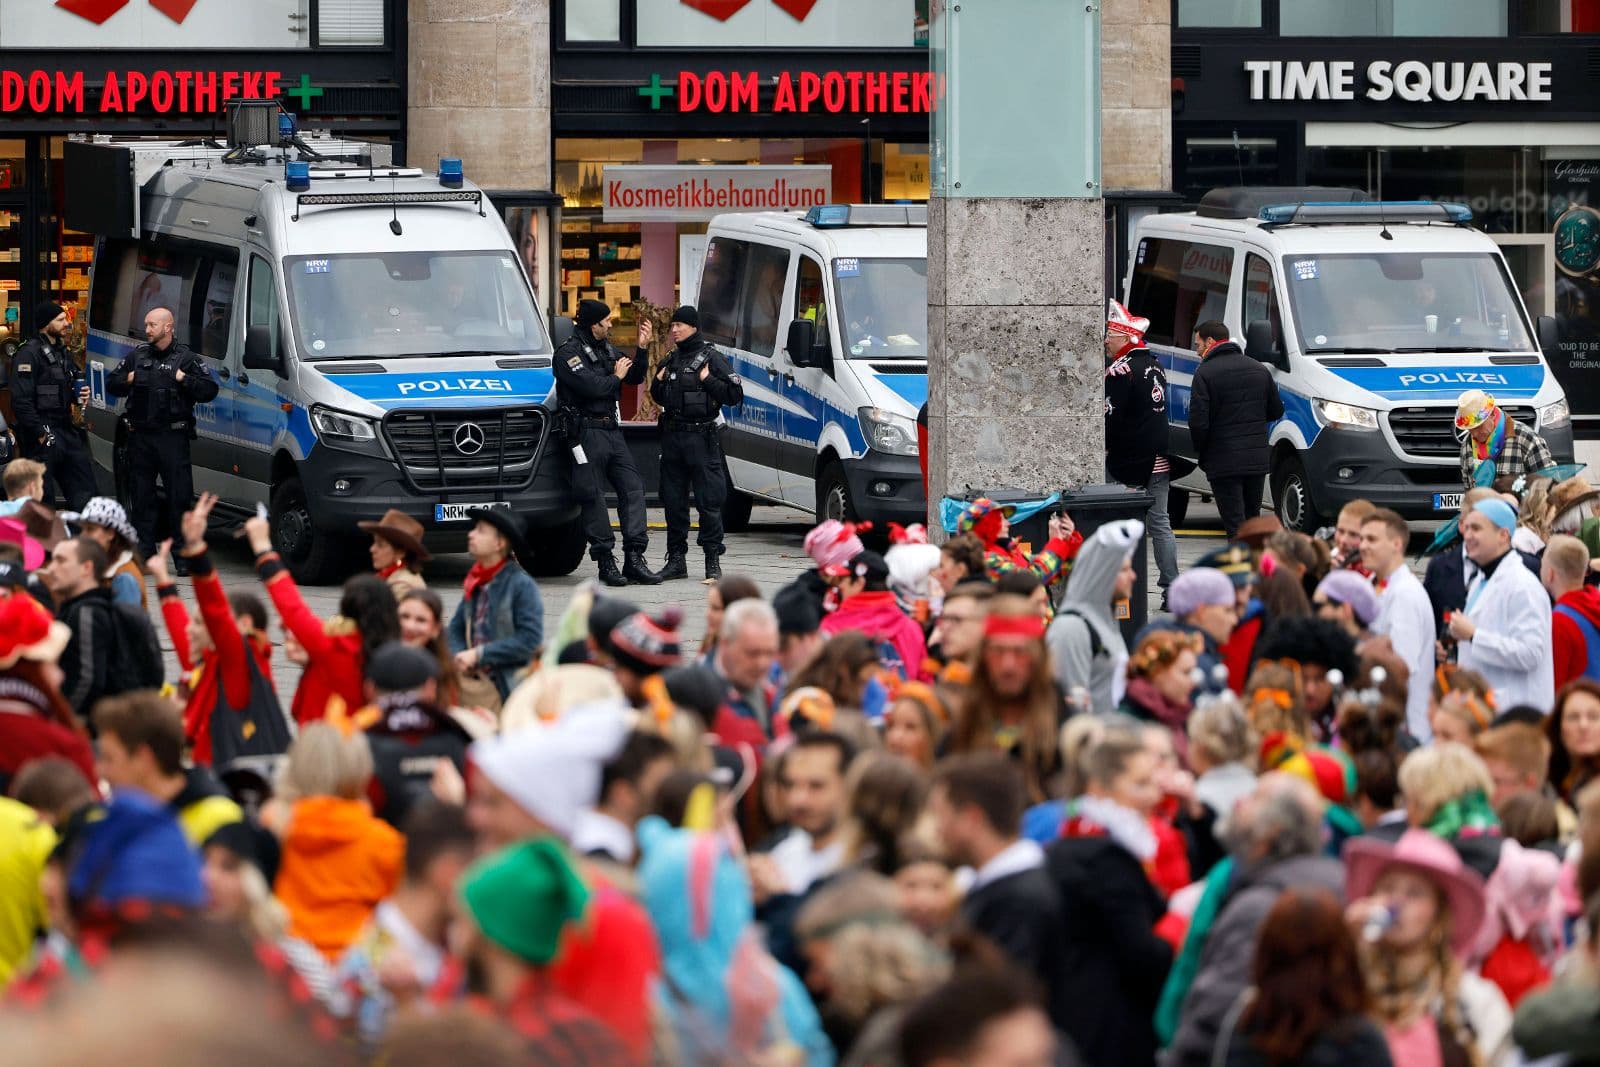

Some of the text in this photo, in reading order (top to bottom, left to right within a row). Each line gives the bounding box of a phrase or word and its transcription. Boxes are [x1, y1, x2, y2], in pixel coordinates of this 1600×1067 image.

[1244, 60, 1553, 102] TIME SQUARE
[2, 70, 281, 113] DOM APOTHEKE
[679, 70, 945, 113] DOM APOTHEK
[306, 259, 328, 267] NRW
[836, 258, 858, 266] NRW
[1294, 260, 1316, 269] NRW
[1559, 342, 1577, 351] OUD
[1578, 342, 1589, 351] TO
[1573, 351, 1587, 360] THE
[397, 378, 513, 395] POLIZEI
[1398, 372, 1509, 387] POLIZEI
[193, 402, 217, 424] OLIZEI
[742, 403, 768, 425] POLIZEI
[1440, 494, 1461, 507] NRW
[442, 504, 465, 519] NRW
